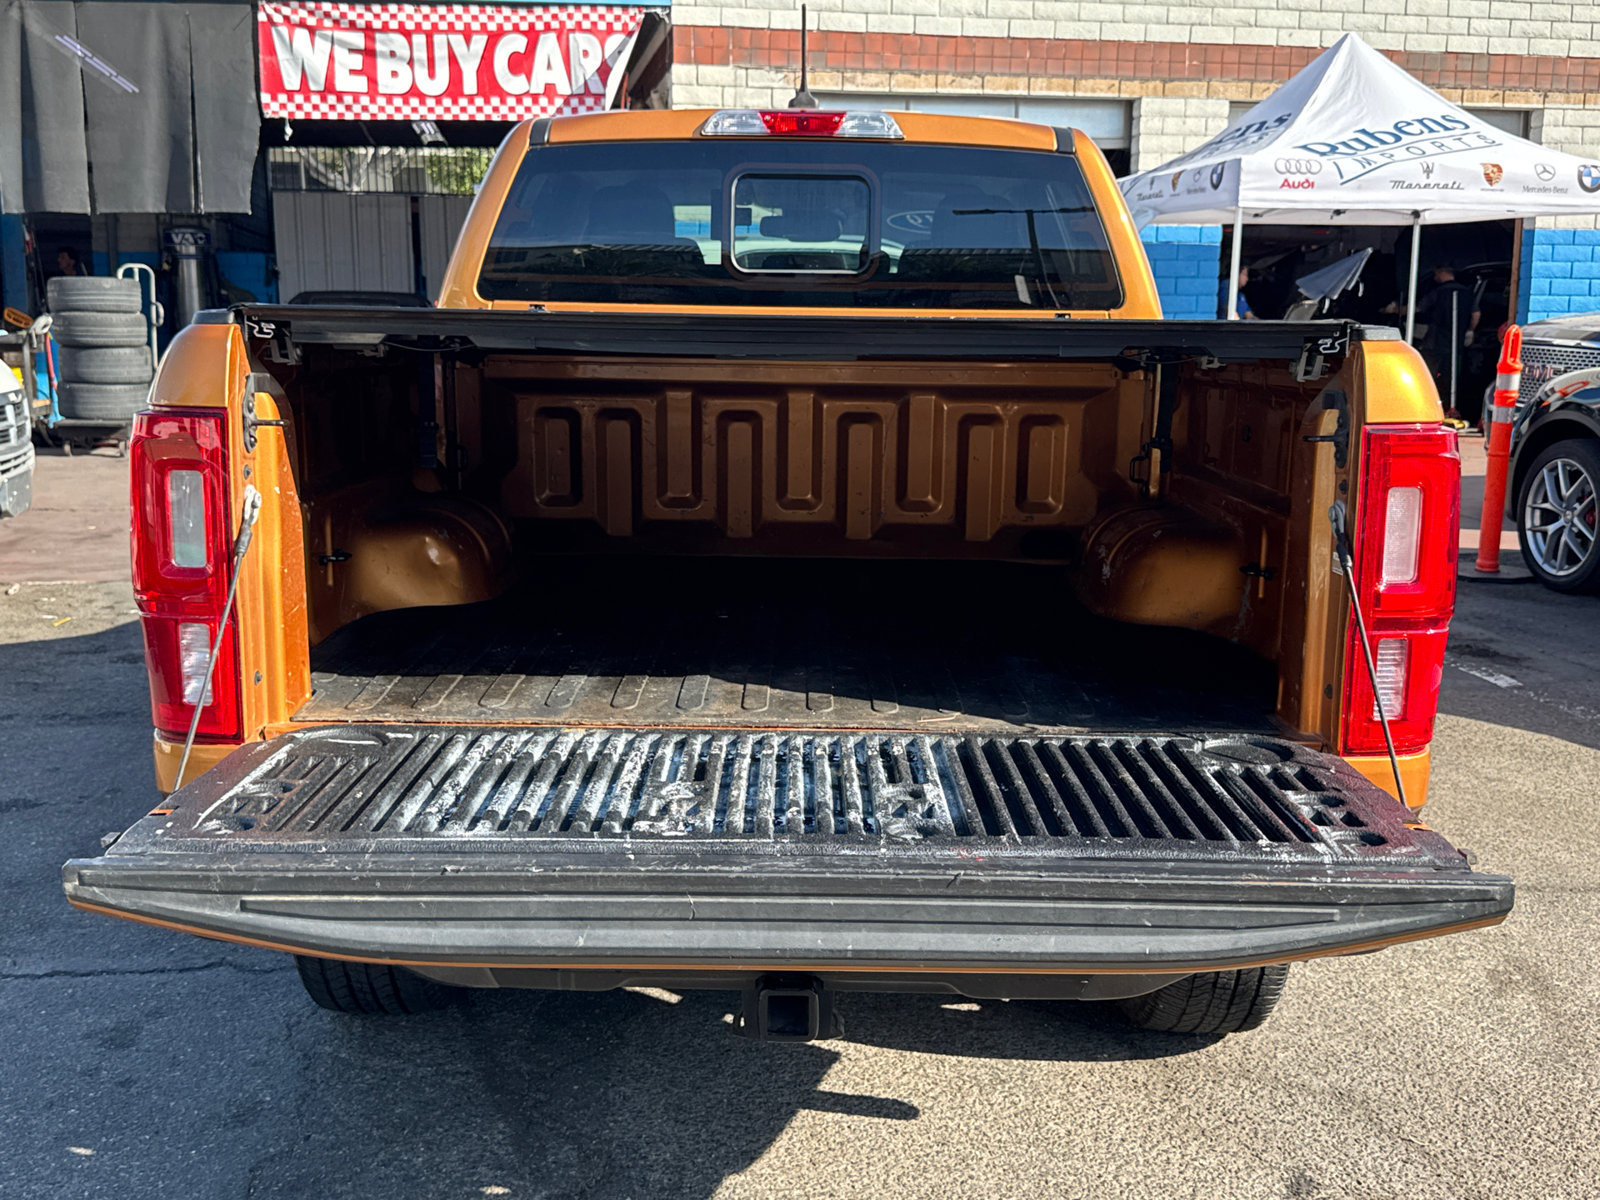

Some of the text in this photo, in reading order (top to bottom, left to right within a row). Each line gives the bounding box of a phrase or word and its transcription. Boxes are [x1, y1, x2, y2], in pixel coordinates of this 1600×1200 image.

[271, 26, 369, 94] WE
[374, 32, 488, 96] BUY
[1293, 114, 1471, 157] Rubens
[1332, 133, 1497, 181] IMPORTS
[1279, 177, 1316, 190] Audi
[1388, 179, 1465, 191] Maserati
